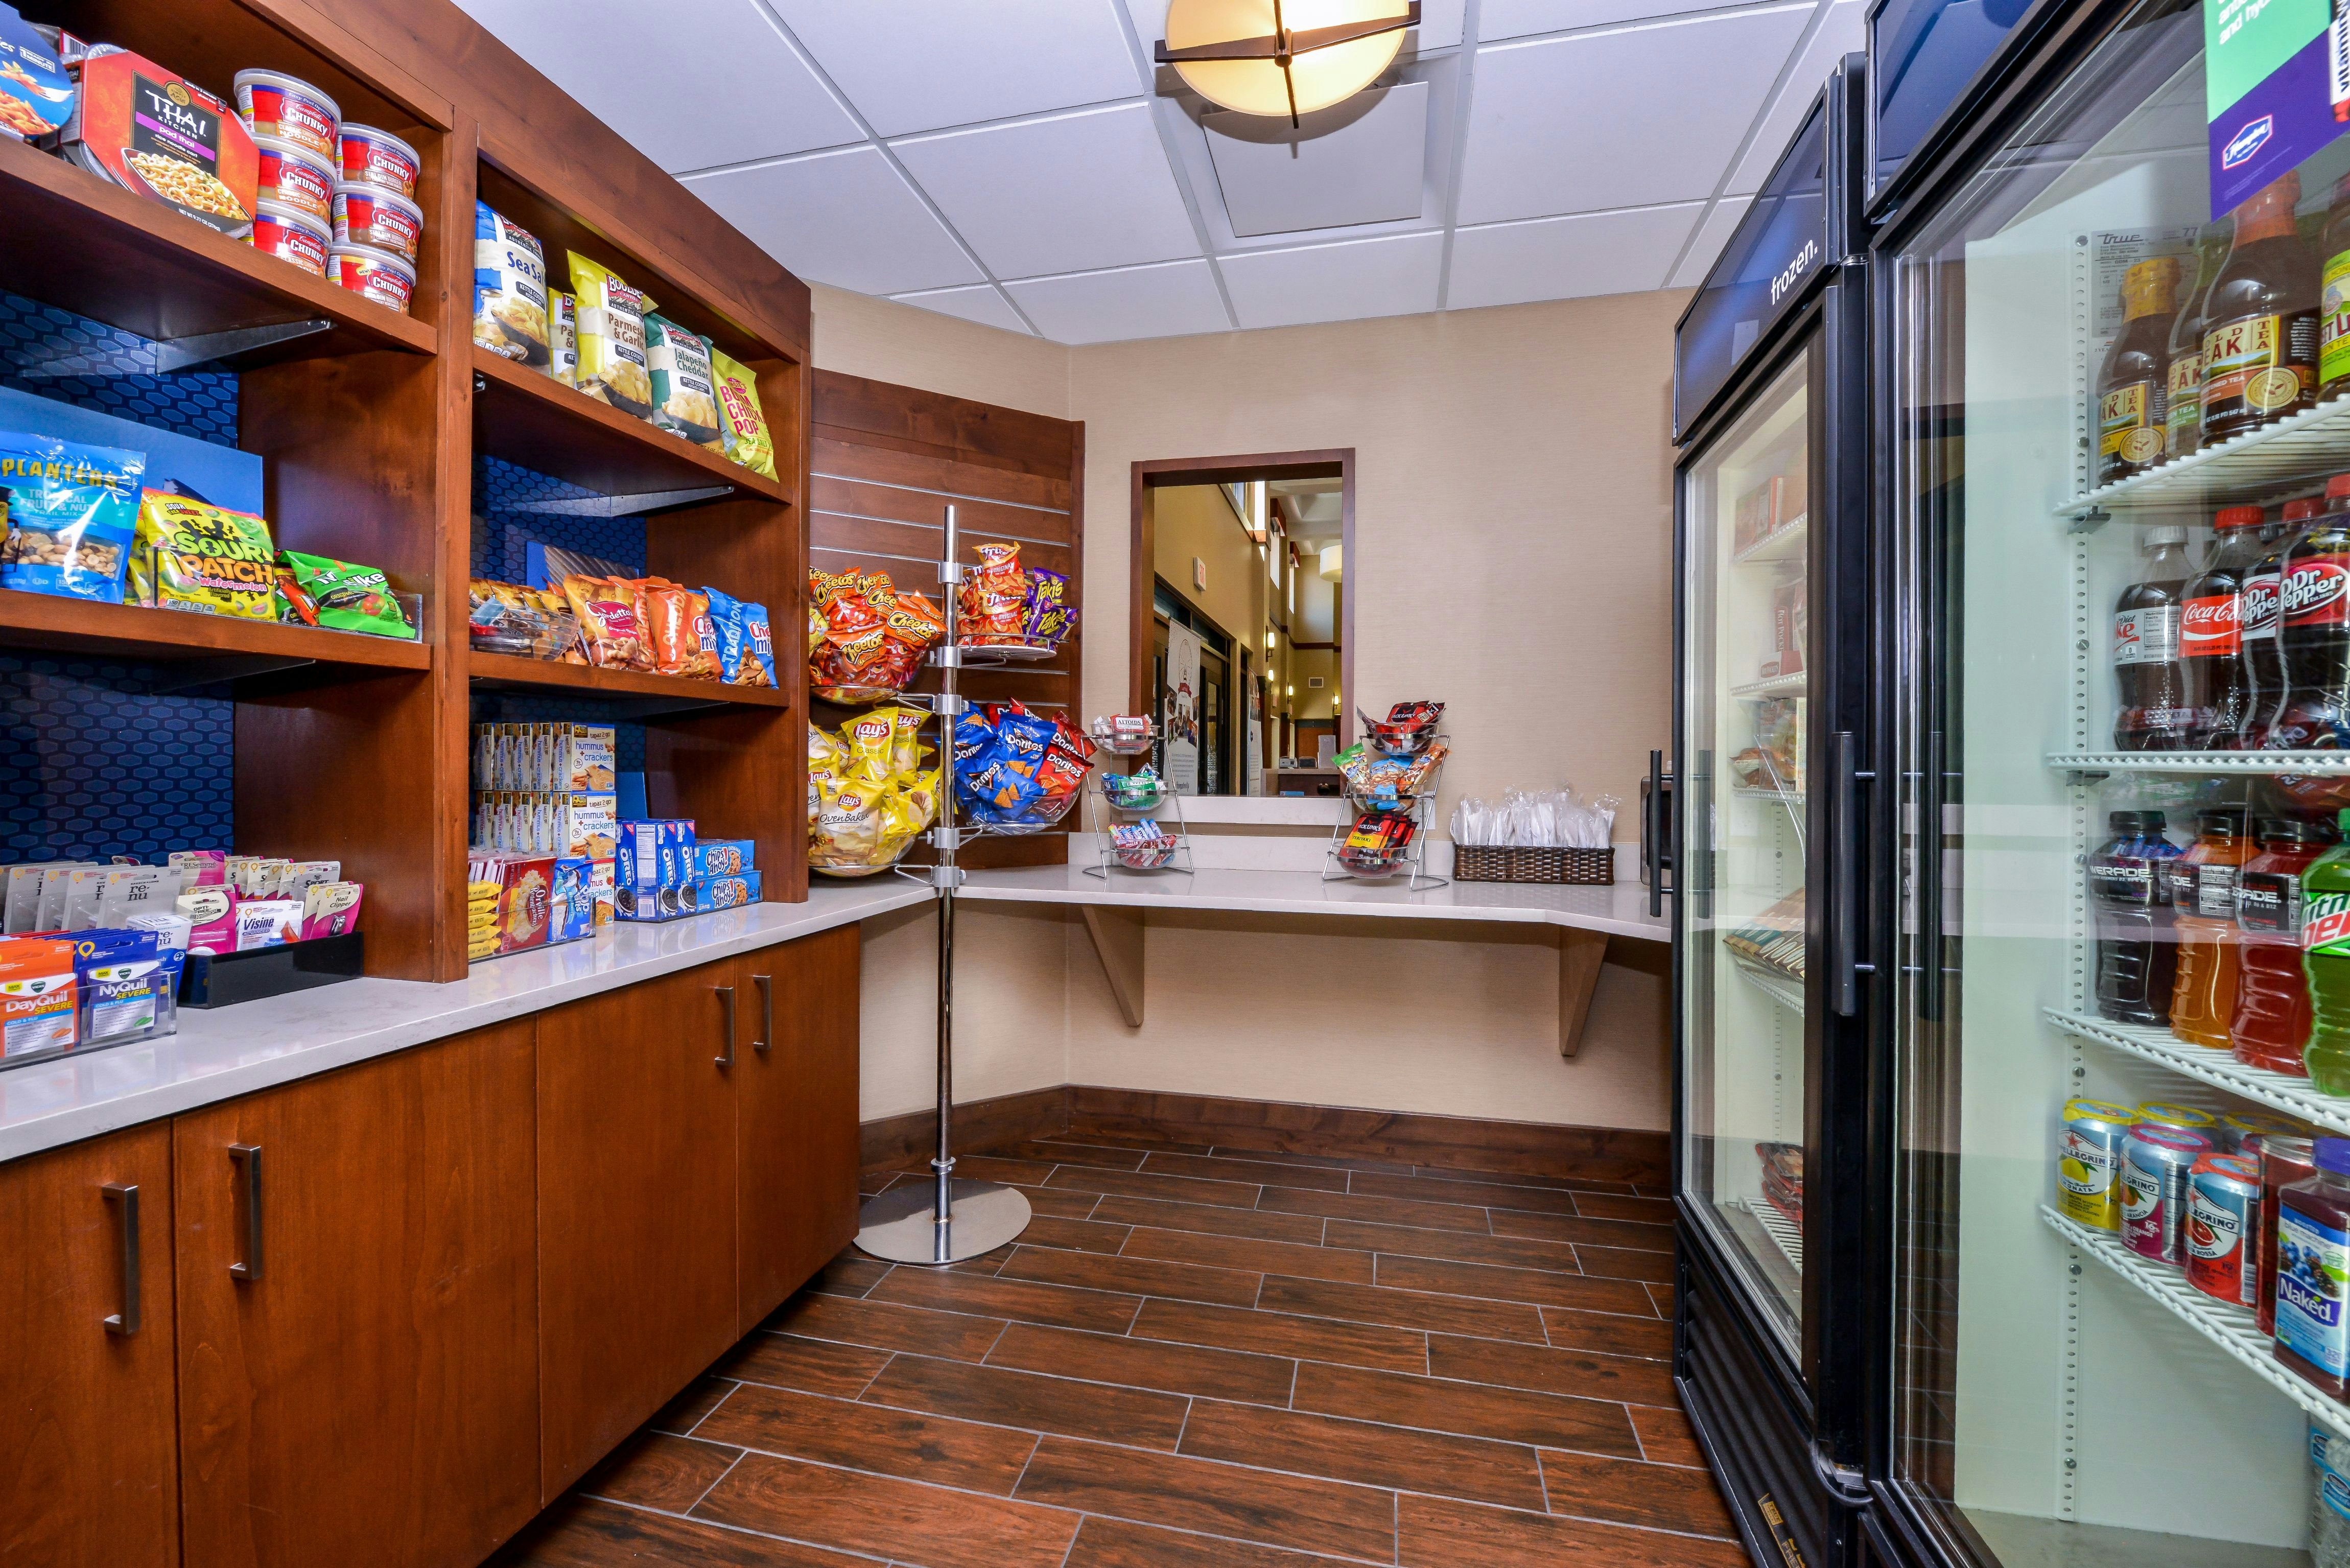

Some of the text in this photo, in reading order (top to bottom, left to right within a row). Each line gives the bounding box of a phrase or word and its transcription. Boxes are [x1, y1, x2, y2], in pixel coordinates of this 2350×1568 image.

[27, 55, 53, 69] MINUTE
[145, 90, 206, 135] THAI
[289, 92, 332, 118] Easy Peel Opening
[158, 115, 197, 139] KITCHEN
[286, 107, 328, 135] CHUNKY
[159, 126, 195, 148] pad thai
[279, 130, 319, 146] NOODLE
[167, 139, 186, 152] noodle
[186, 149, 198, 157] cart
[396, 150, 411, 163] Opening
[302, 161, 313, 170] Peel
[373, 155, 409, 180] CHUNKY
[286, 171, 325, 199] CHUNKY
[293, 224, 315, 237] Easy Peel
[378, 214, 413, 238] CHUNKY
[290, 239, 325, 265] CHUNKY
[507, 251, 530, 276] Sea
[373, 276, 406, 300] CHUNKY
[520, 283, 533, 296] KETTLE
[620, 292, 638, 302] CANYON
[611, 303, 634, 315] AUTHENTIC
[614, 327, 644, 350] & Garlic
[618, 346, 643, 361] KETTLE COOKED
[674, 348, 707, 370] Jalapeño
[676, 360, 709, 380] Cheddar
[695, 381, 708, 390] COOKED
[2179, 405, 2195, 414] TEA
[734, 418, 759, 437] POP
[2, 459, 118, 490] PLANTERS
[175, 532, 264, 564] SOUR
[178, 555, 274, 584] PATCH
[198, 577, 267, 592] Watermelon
[815, 574, 855, 604] Cheetos
[2293, 570, 2321, 592] Dr
[1037, 581, 1063, 602] Takis
[2249, 588, 2271, 609] Dr
[2281, 574, 2344, 612] Pepper
[888, 612, 936, 640] Cheetos
[2119, 615, 2136, 623] Diet
[896, 629, 919, 642] Crunchy
[858, 651, 879, 665] Crunchy
[855, 722, 889, 739] Lay's
[1006, 734, 1043, 752] Doritos
[584, 752, 613, 761] crackers
[1047, 753, 1083, 778] Doritos
[970, 761, 1000, 792] Doritos
[838, 795, 861, 807] Lay's
[574, 810, 604, 820] hummus
[583, 822, 614, 830] crackers
[707, 849, 724, 865] Chips
[729, 846, 741, 854] ORIGINAL
[619, 847, 632, 886] OREO
[662, 847, 673, 885] OREO
[682, 845, 693, 882] OREO
[712, 882, 730, 898] Chips
[734, 877, 747, 886] ORIGINAL
[535, 890, 546, 920] Orville
[244, 918, 274, 930] Visine
[99, 978, 148, 996] NyQuil
[116, 988, 151, 999] SEVERE
[6, 991, 67, 1013] DayQuil
[34, 1000, 74, 1015] SEVERE
[2133, 1226, 2153, 1237] ORANGE
[2280, 1278, 2334, 1323] Naked
